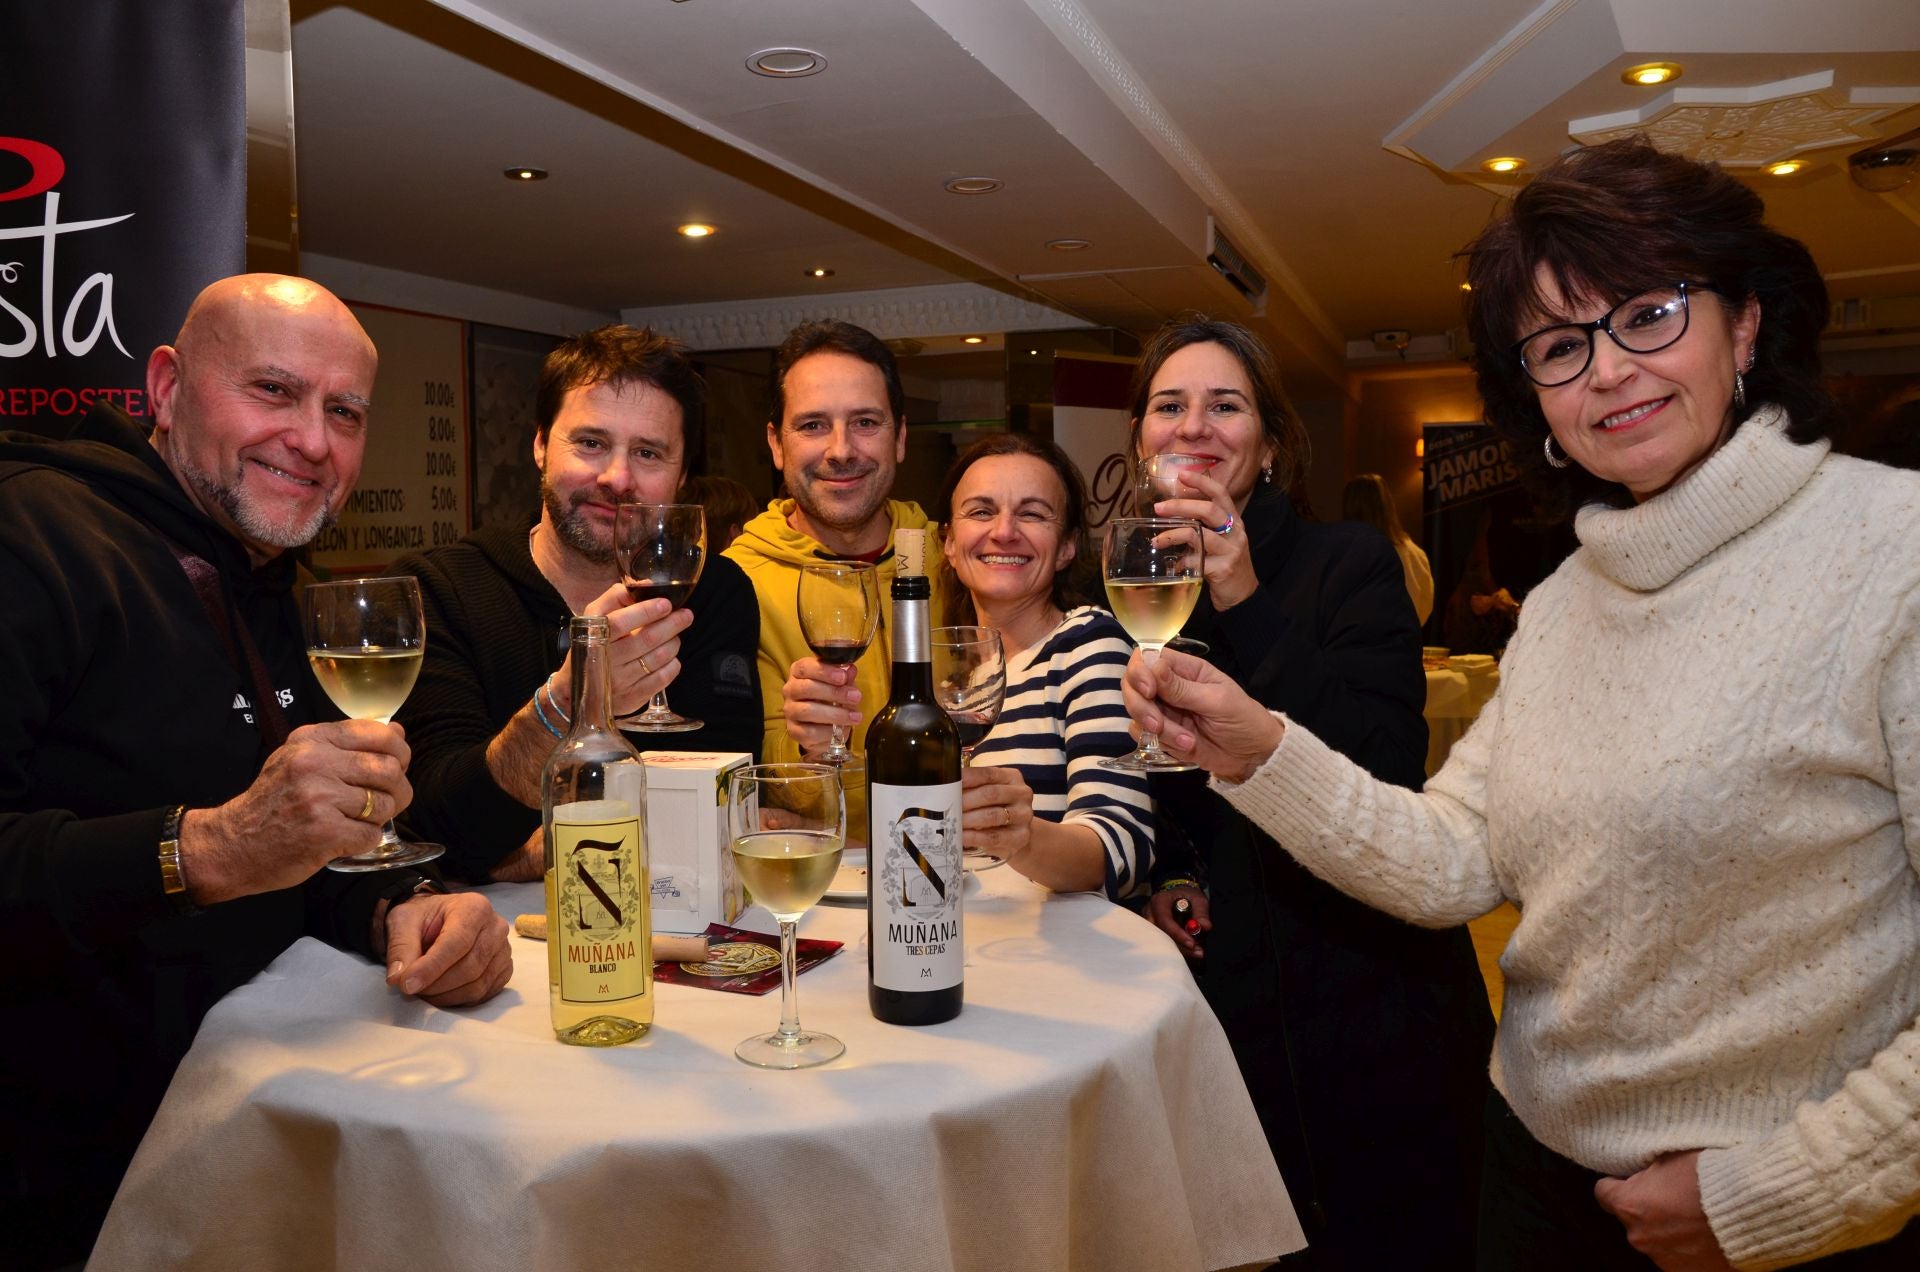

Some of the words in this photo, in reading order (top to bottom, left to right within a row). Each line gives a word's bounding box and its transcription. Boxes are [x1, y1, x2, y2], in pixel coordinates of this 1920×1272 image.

[425, 381, 455, 408] 10.00€
[429, 417, 457, 443] 8.00€
[426, 452, 457, 477] 10.00€
[431, 485, 458, 512] 5.00€
[351, 526, 360, 551] Y
[433, 521, 458, 546] 8.00€
[888, 919, 958, 944] MUÑANA
[568, 940, 636, 964] MUÑANA
[906, 945, 924, 956] TRES
[925, 943, 946, 955] CEPAS
[589, 962, 617, 974] BLANCO
